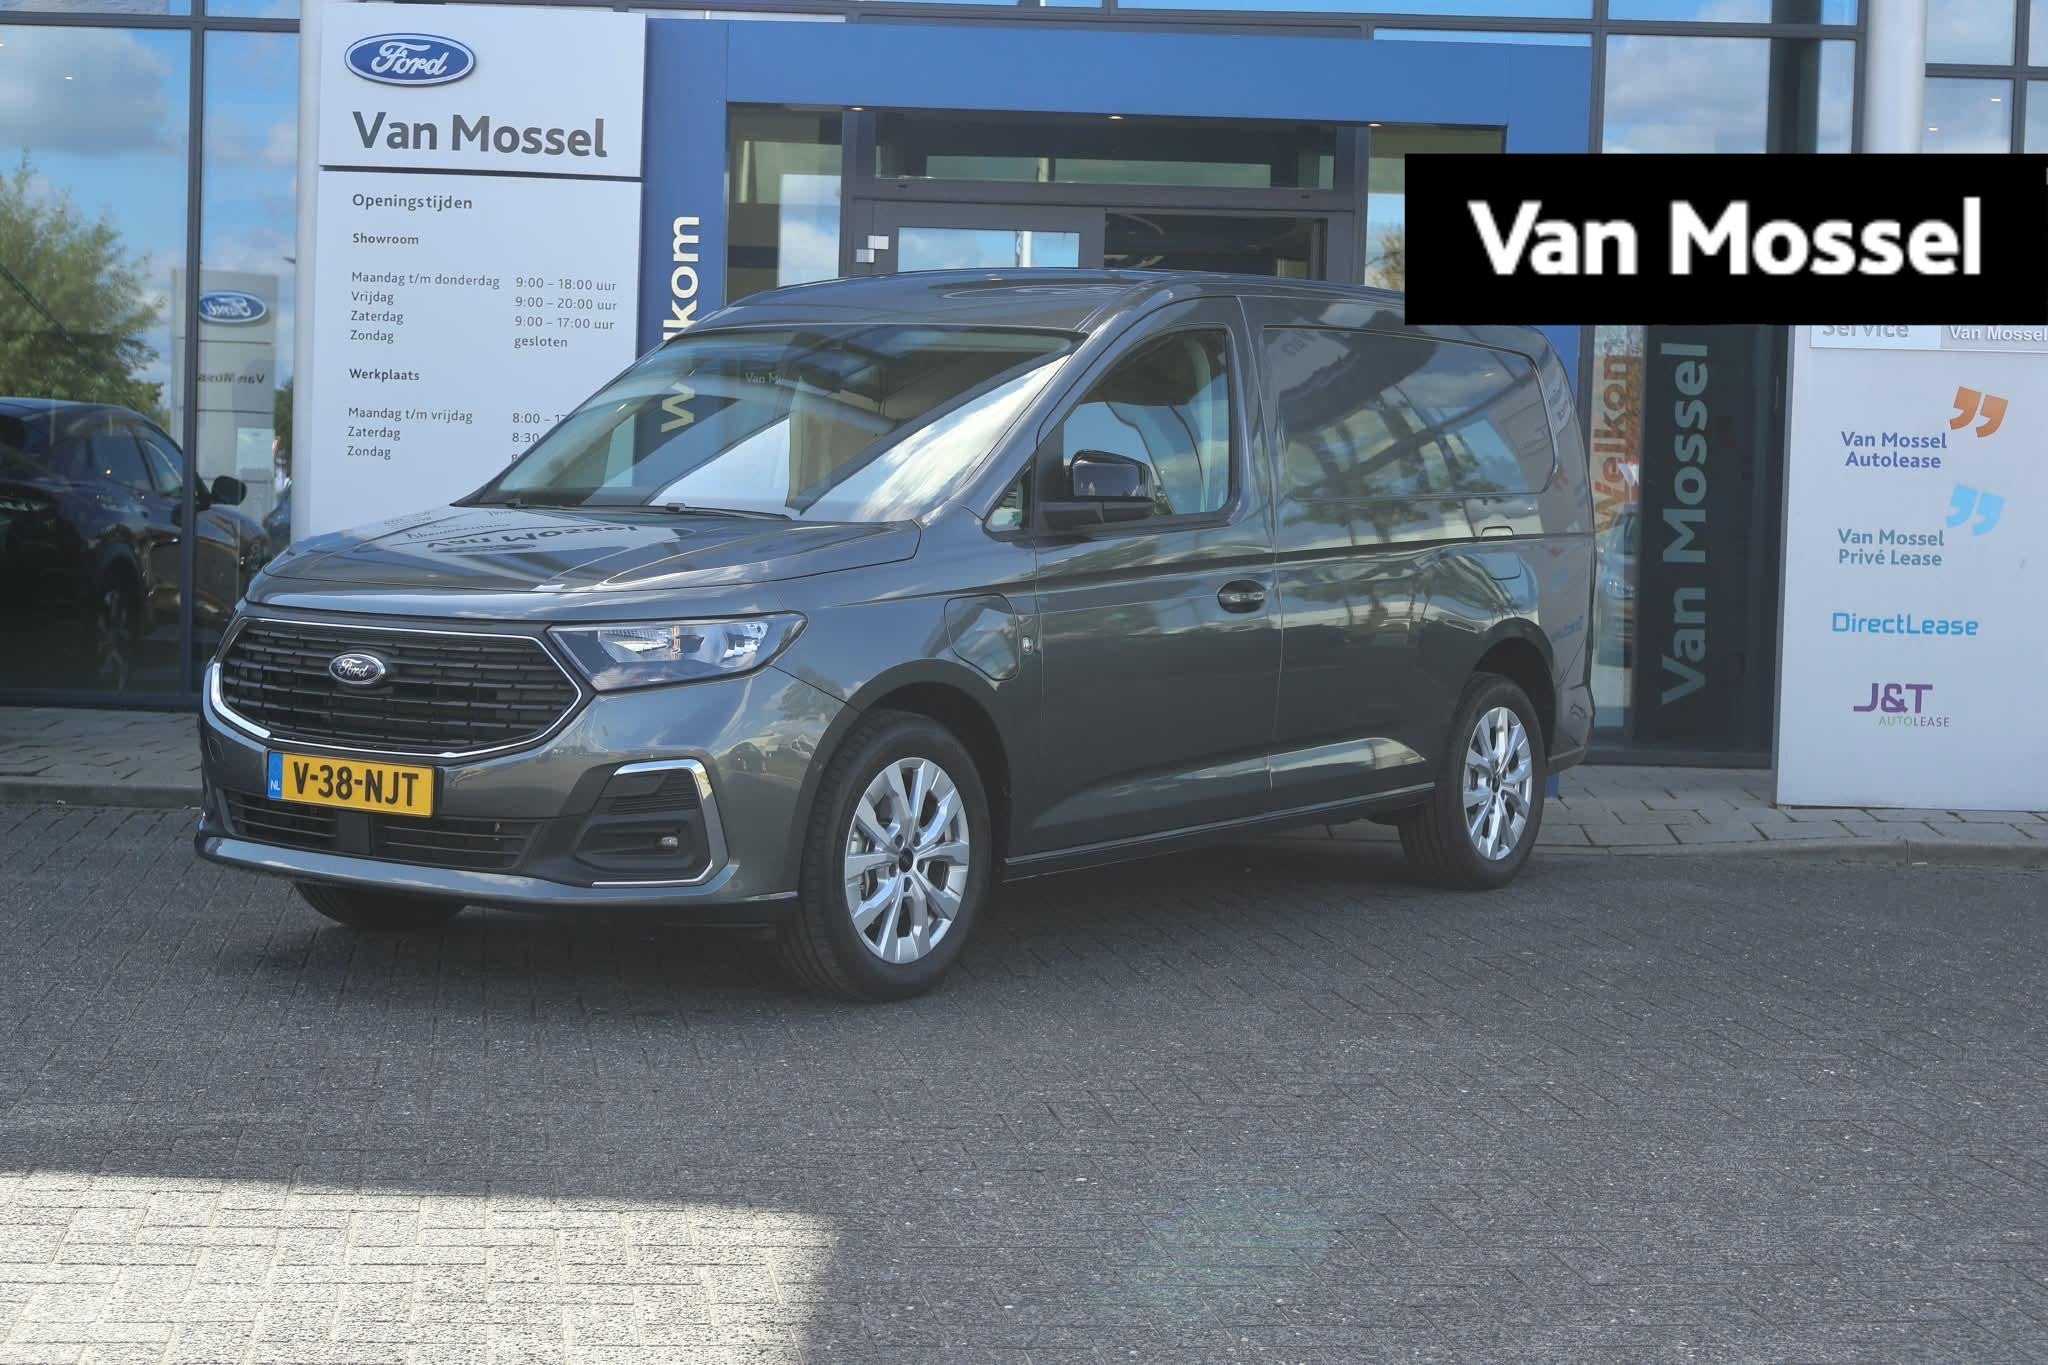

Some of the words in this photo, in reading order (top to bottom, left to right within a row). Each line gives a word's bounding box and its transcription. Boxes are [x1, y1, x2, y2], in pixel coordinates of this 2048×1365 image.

[371, 41, 448, 76] Ford
[352, 111, 438, 150] Van
[451, 114, 608, 158] Mossel
[352, 193, 473, 212] Openingstijden
[352, 233, 419, 245] Showroom
[351, 271, 405, 287] Maandag
[408, 272, 431, 285] t/m
[434, 273, 500, 290] donderdag
[515, 276, 544, 289] 9:00
[557, 278, 593, 291] 18:00
[596, 282, 617, 292] uur
[351, 290, 394, 306] Vrijdag
[515, 296, 544, 308] 9:00
[556, 297, 593, 310] 20:00
[597, 302, 617, 311] uur
[350, 310, 404, 326] Zaterdag
[515, 316, 543, 328] 9:00
[557, 317, 591, 329] 17:00
[594, 321, 615, 330] uur
[350, 329, 394, 345] Zondag
[513, 336, 568, 349] gesloten
[1949, 325, 1982, 341] Van
[1987, 325, 2048, 343] Mossel
[349, 368, 420, 383] Werkplaats
[348, 407, 402, 422] Maandag
[405, 408, 428, 421] t/m
[431, 409, 473, 425] vrijdag
[512, 412, 541, 424] 8:00
[347, 426, 401, 442] Zaterdag
[512, 432, 540, 444] 8:30
[1840, 431, 1876, 447] Van
[1881, 432, 1948, 449] Mossel
[347, 445, 391, 461] Zondag
[1660, 342, 1708, 564] Mossel
[1845, 451, 1942, 469] Autolease
[1837, 528, 1873, 545] Van
[1878, 529, 1945, 547] Mossel
[1838, 548, 1886, 566] Privé
[1890, 549, 1943, 567] Lease
[1831, 612, 1979, 636] DirectLease
[1661, 588, 1708, 705] Van
[1852, 683, 1934, 714] J&T
[1878, 716, 1951, 728] AUTOLEASE
[270, 777, 281, 791] NL
[292, 760, 420, 808] V-38-NJT
